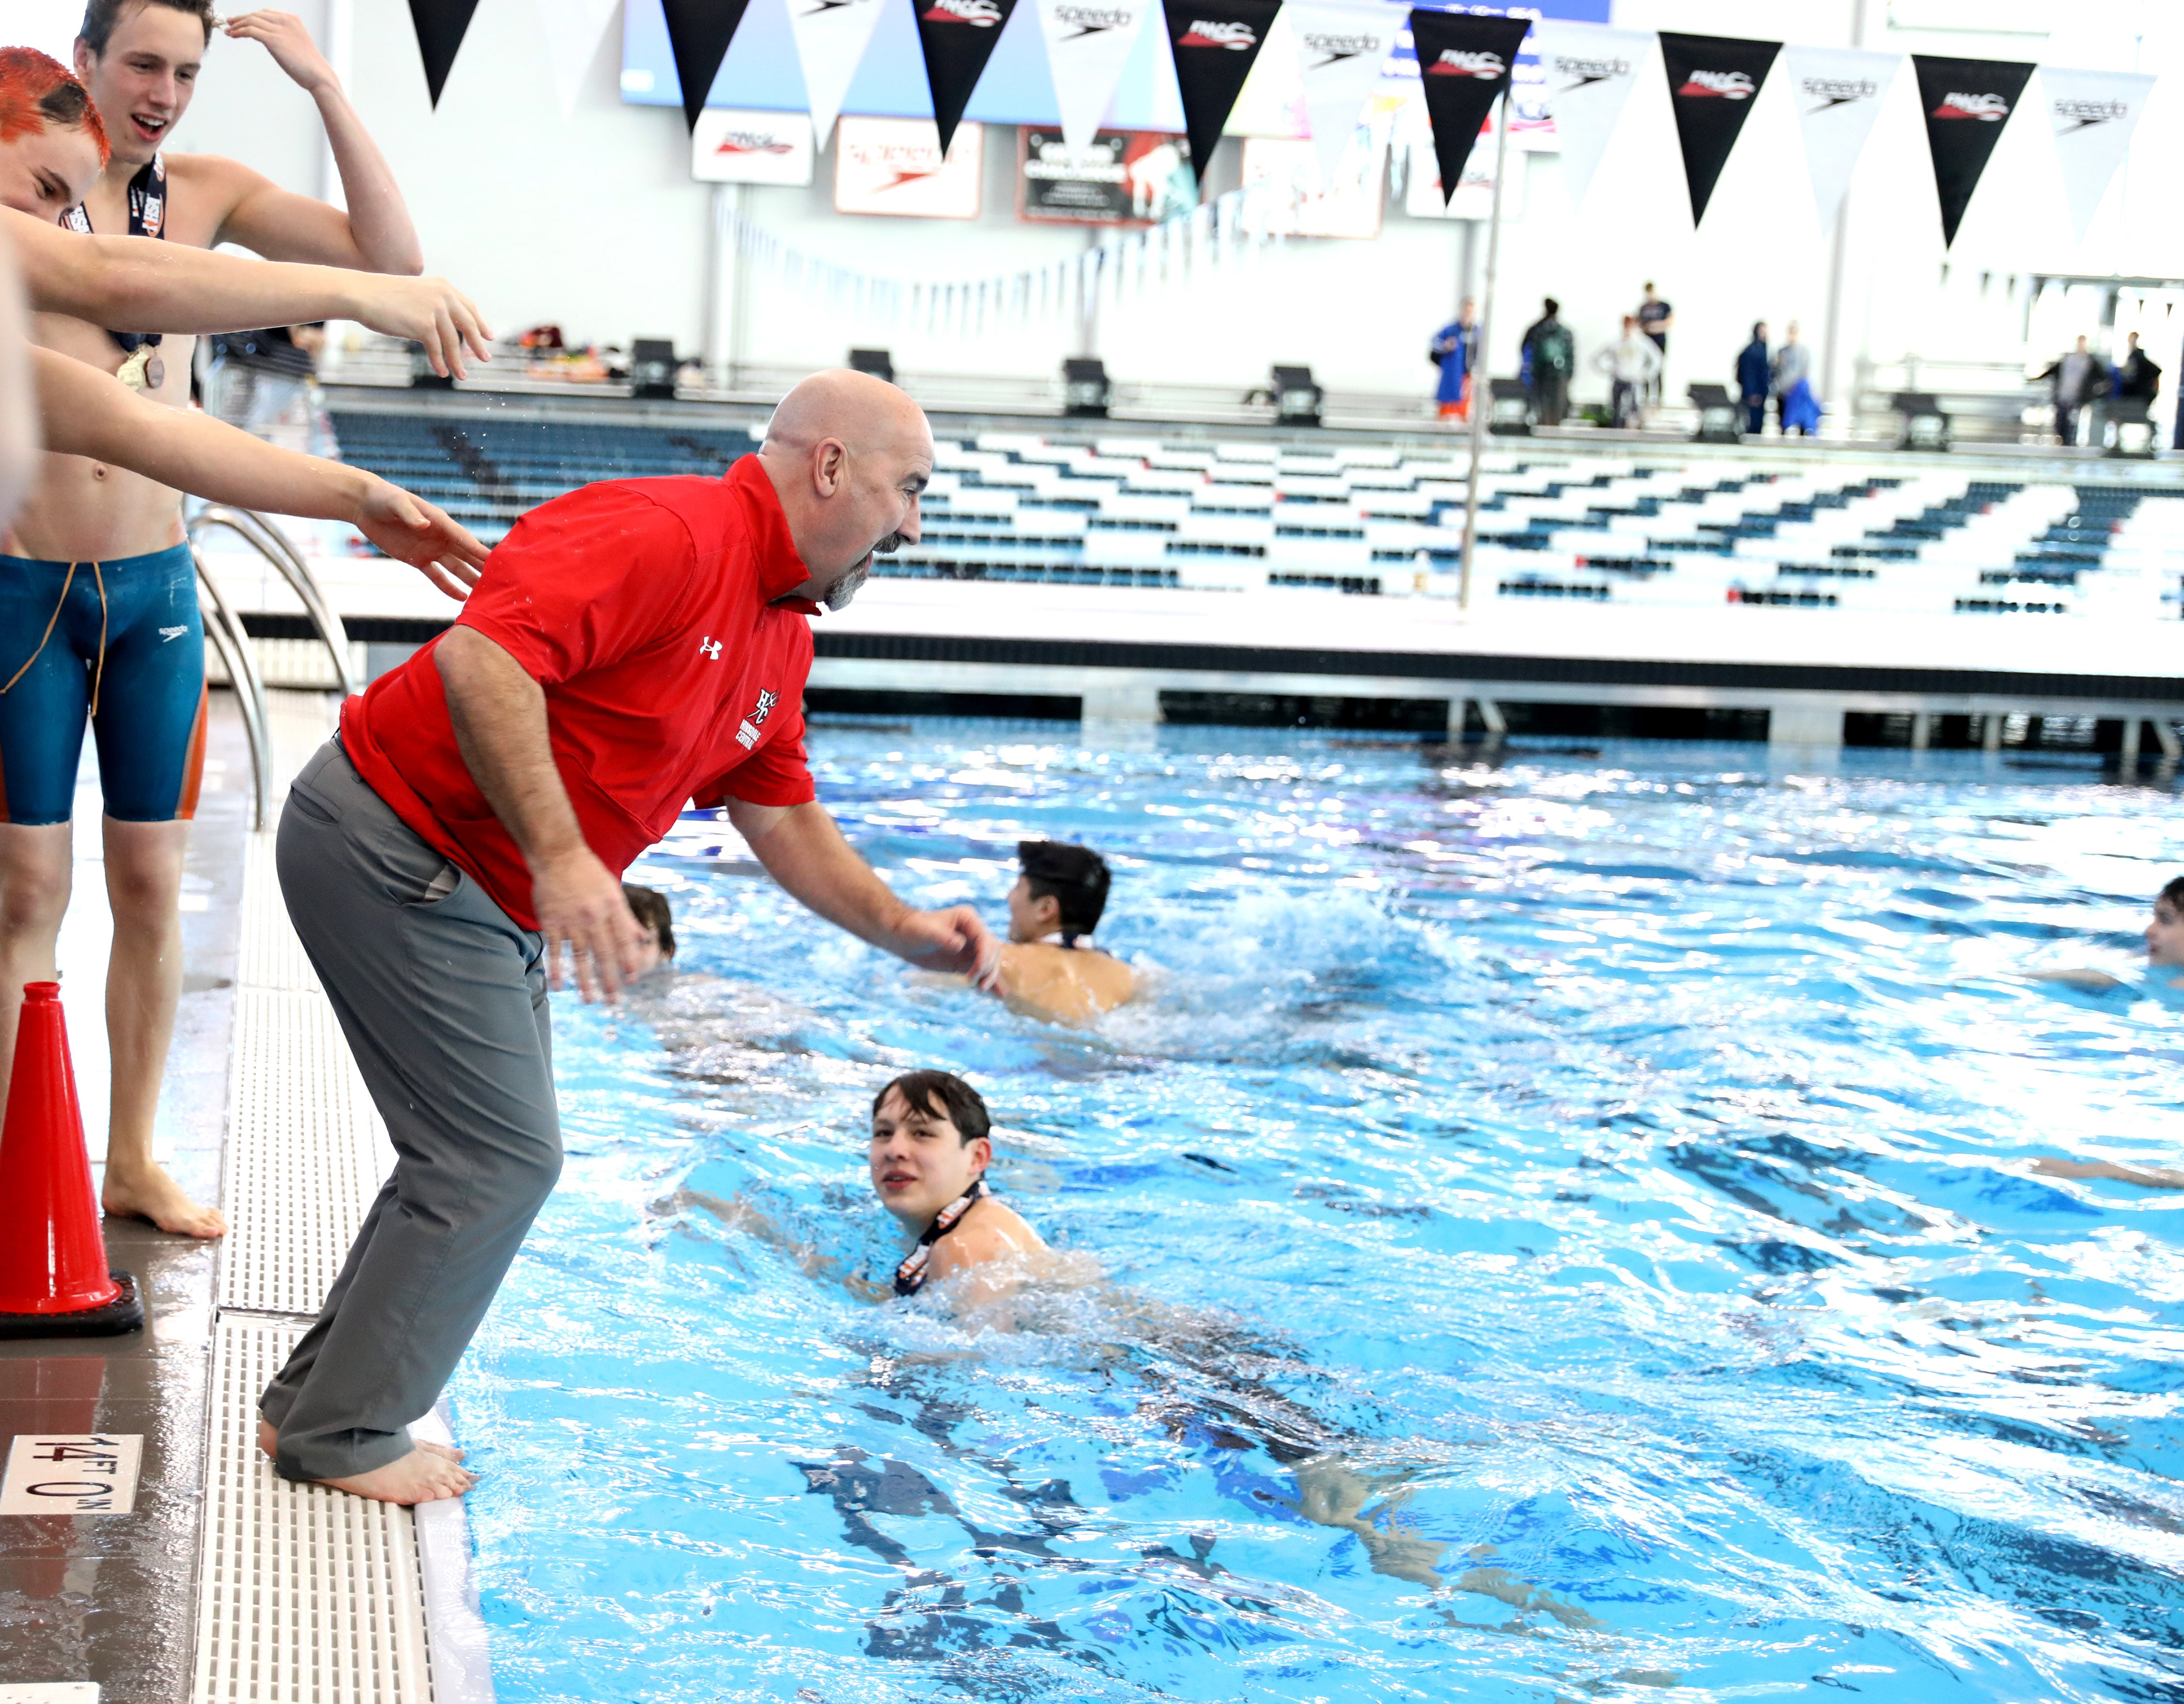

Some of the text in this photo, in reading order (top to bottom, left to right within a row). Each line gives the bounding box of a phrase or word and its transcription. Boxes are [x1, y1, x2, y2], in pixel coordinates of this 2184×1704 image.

[1055, 5, 1132, 27] speedo
[1304, 32, 1380, 52] speedo
[1554, 55, 1630, 76] speedo
[1802, 76, 1877, 98] speedo
[2053, 99, 2127, 118] speedo
[739, 718, 761, 742] HINSDALE
[33, 1438, 119, 1462] 14
[82, 1460, 117, 1474] FT
[76, 1499, 113, 1510] IN
